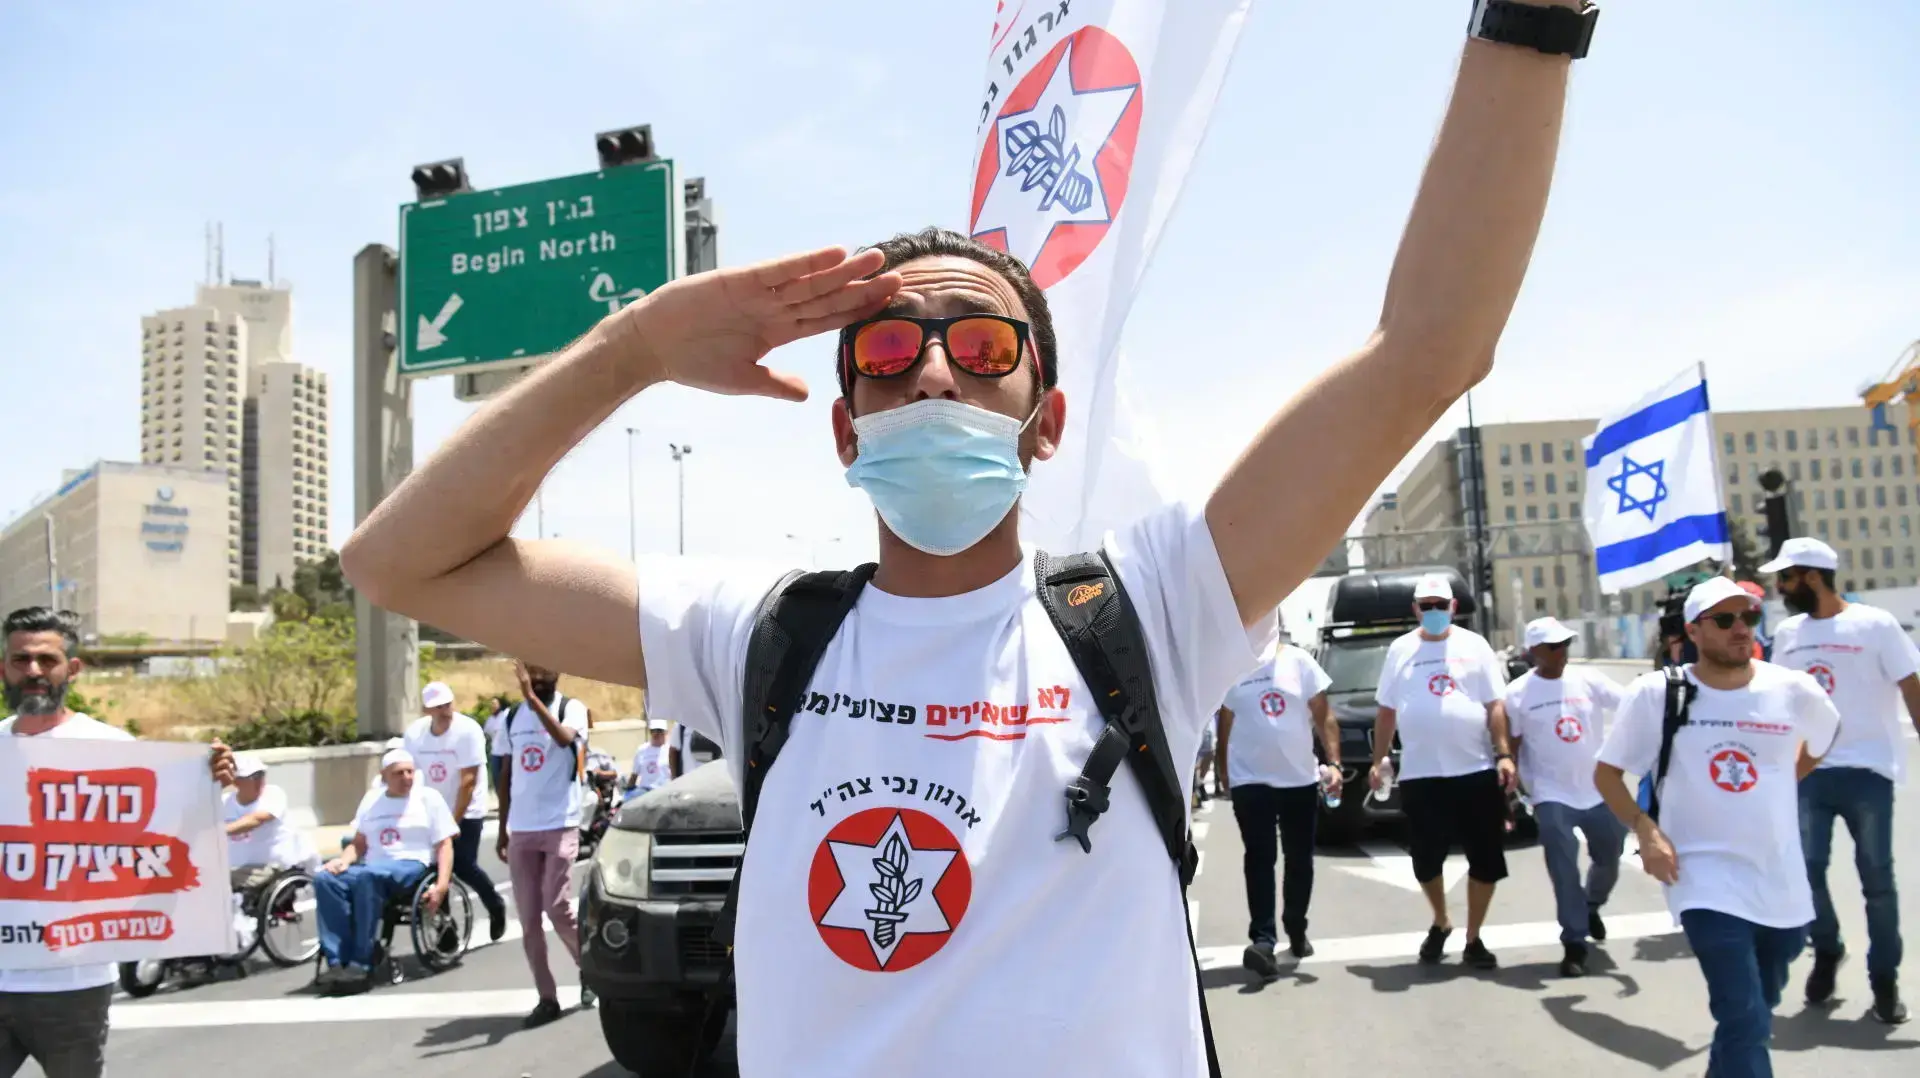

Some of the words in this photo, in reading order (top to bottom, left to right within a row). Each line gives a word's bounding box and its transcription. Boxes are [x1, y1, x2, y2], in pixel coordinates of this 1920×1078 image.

[473, 205, 528, 238] צפון
[452, 245, 525, 274] Begin
[540, 230, 616, 261] North
[1037, 685, 1070, 709] לא
[926, 701, 1028, 726] שאירים
[40, 774, 143, 824] כולנו
[881, 776, 918, 795] נכי
[924, 782, 981, 829] ארגון
[44, 843, 174, 891] איציק
[51, 921, 95, 948] סוף
[101, 916, 166, 940] שמים
